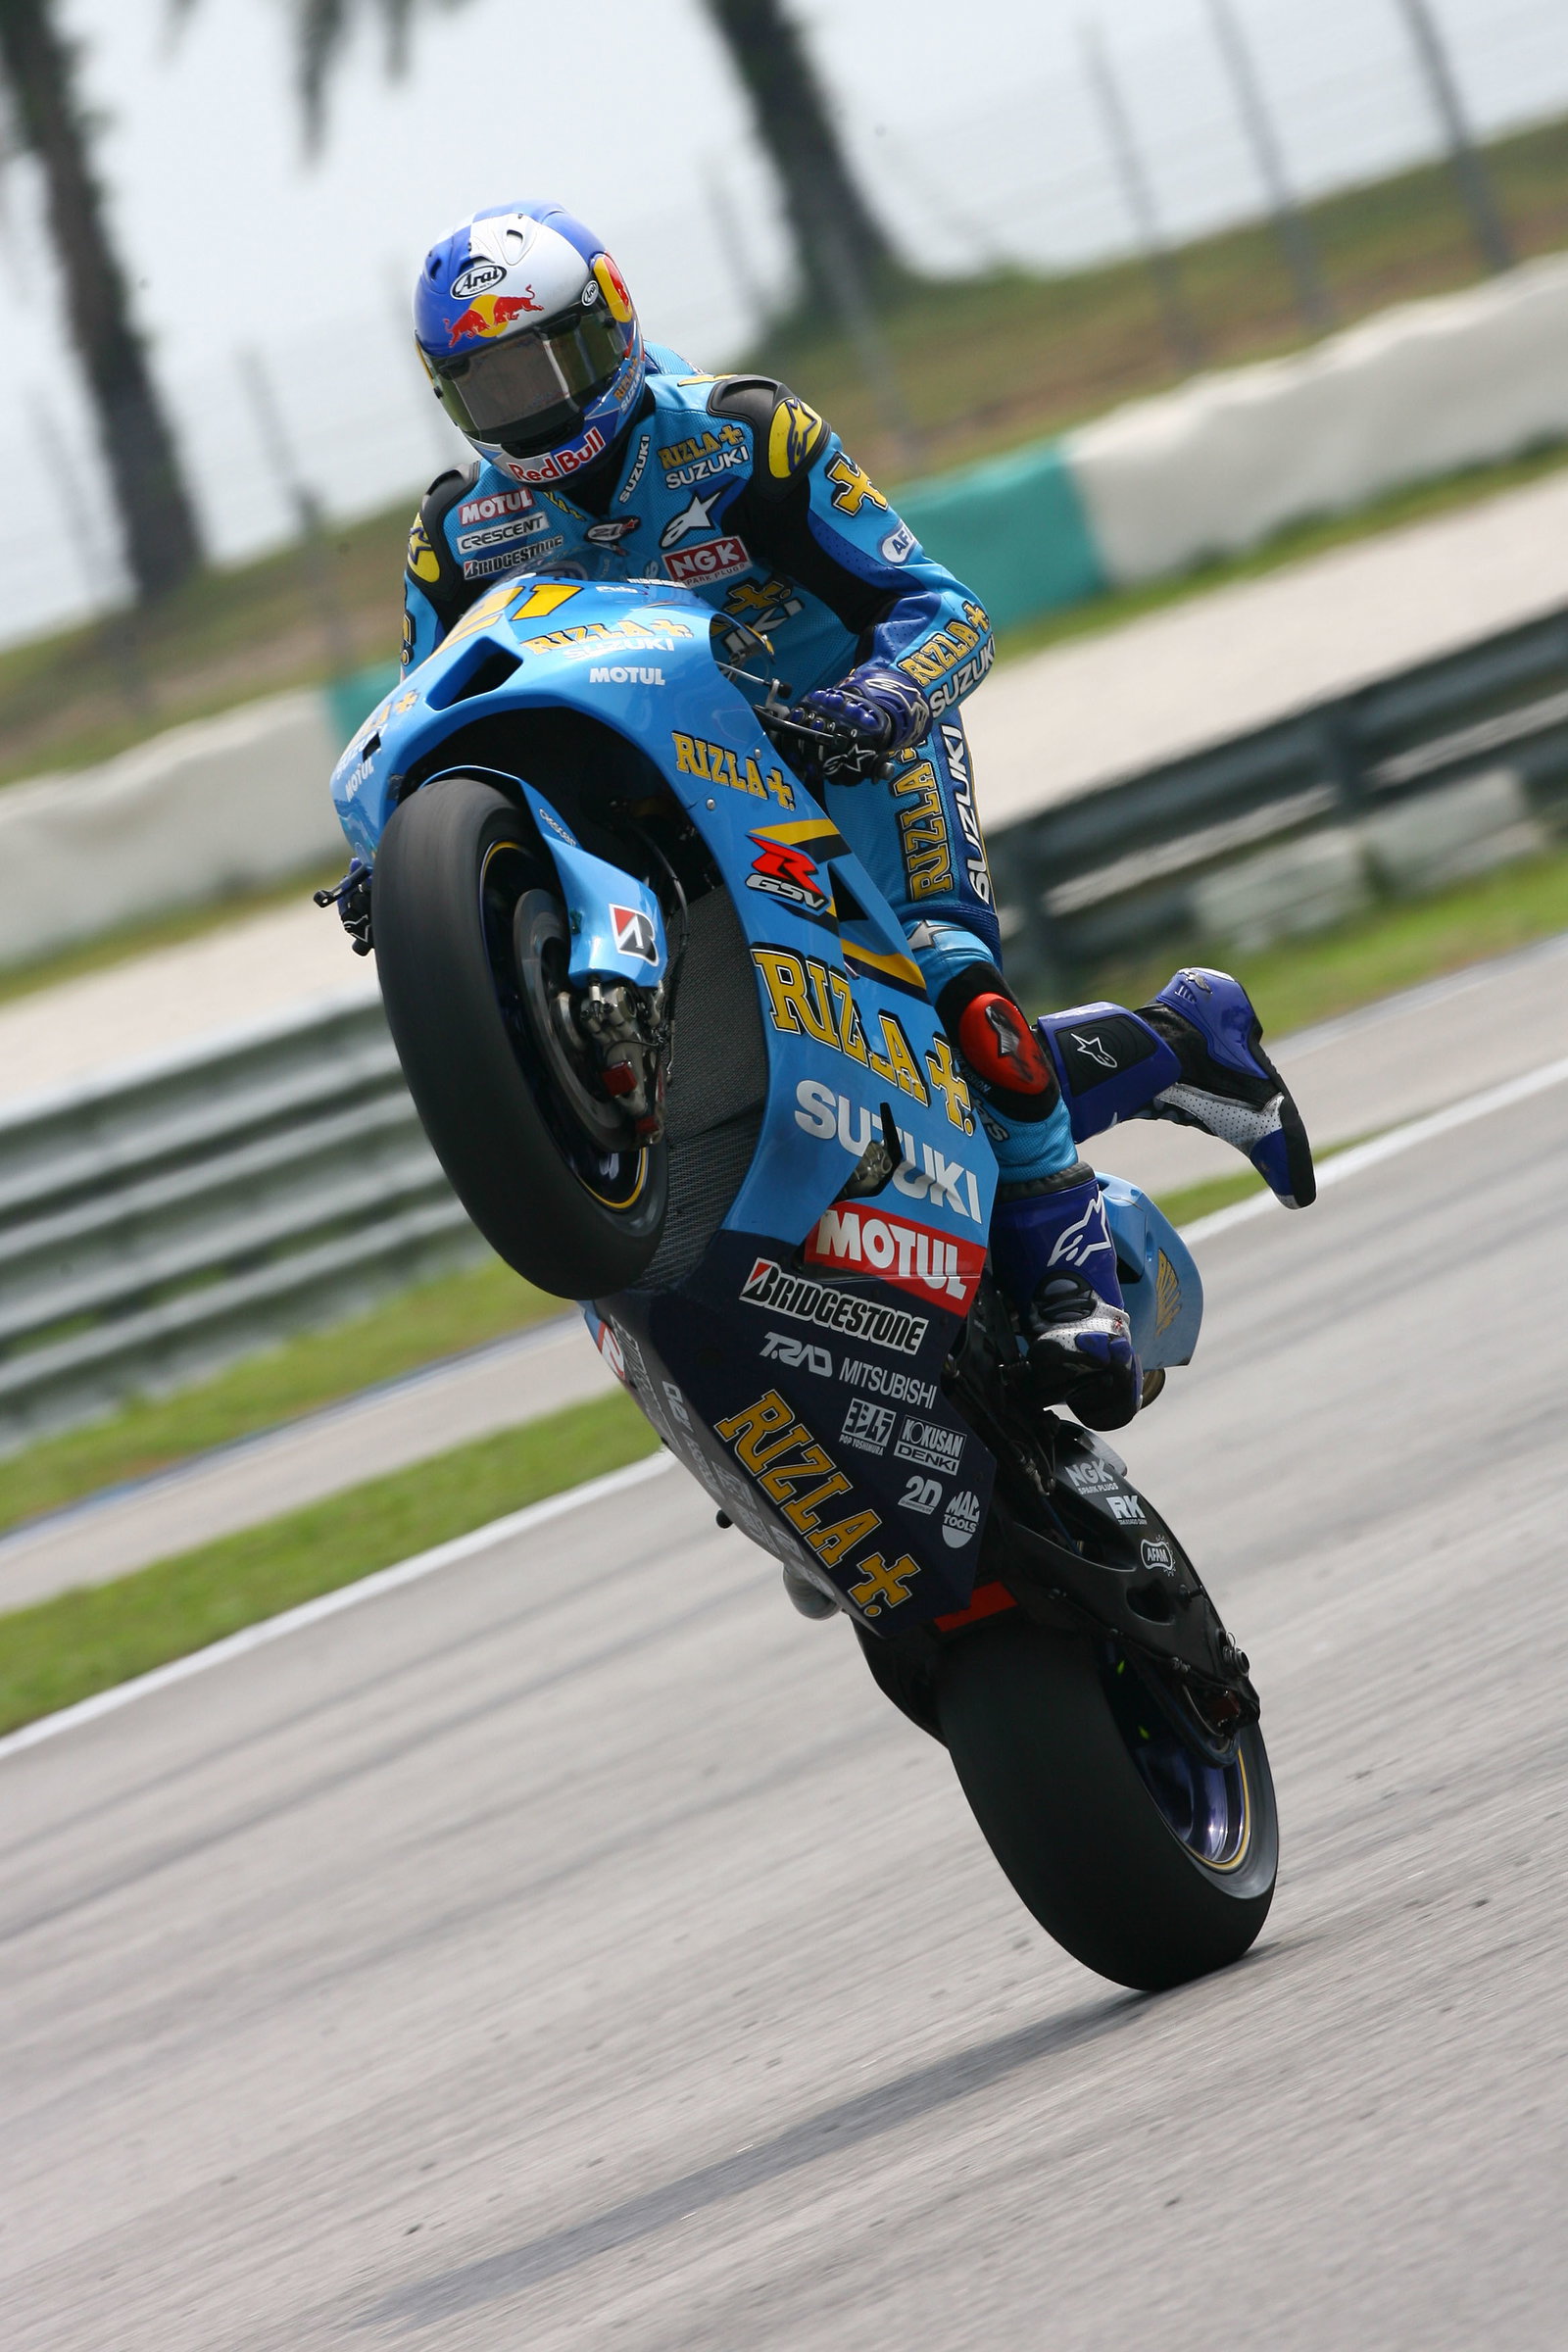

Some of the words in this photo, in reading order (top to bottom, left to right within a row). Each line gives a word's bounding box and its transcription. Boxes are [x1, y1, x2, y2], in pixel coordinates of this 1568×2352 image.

[455, 266, 500, 296] Arai
[508, 459, 561, 483] Red
[554, 426, 607, 473] Bull
[619, 434, 651, 505] SUZUKI
[665, 446, 750, 489] SUZUKI
[461, 489, 533, 525] MOTUL
[461, 516, 543, 551] CRESCENT
[464, 536, 564, 580] BRIDGESTONE
[671, 542, 741, 578] NGK
[682, 574, 713, 586] PARK
[564, 638, 675, 662] SUZUKI
[589, 666, 665, 686] MOTUL
[929, 633, 996, 719] SUZUKI
[746, 873, 829, 915] GSV
[795, 1080, 982, 1225] SUUKI
[815, 1208, 967, 1300] MOTUL
[740, 1257, 929, 1355] BRIDGESTONE
[839, 1357, 937, 1409] MITSUBISHI
[903, 1419, 964, 1458] KOKUSAN
[898, 1446, 957, 1472] DENKI
[1064, 1458, 1114, 1488] NGK
[944, 1514, 977, 1534] TOOLS
[946, 1491, 980, 1523] MAC
[1105, 1494, 1146, 1520] RK
[1147, 1546, 1169, 1563] AFAM
